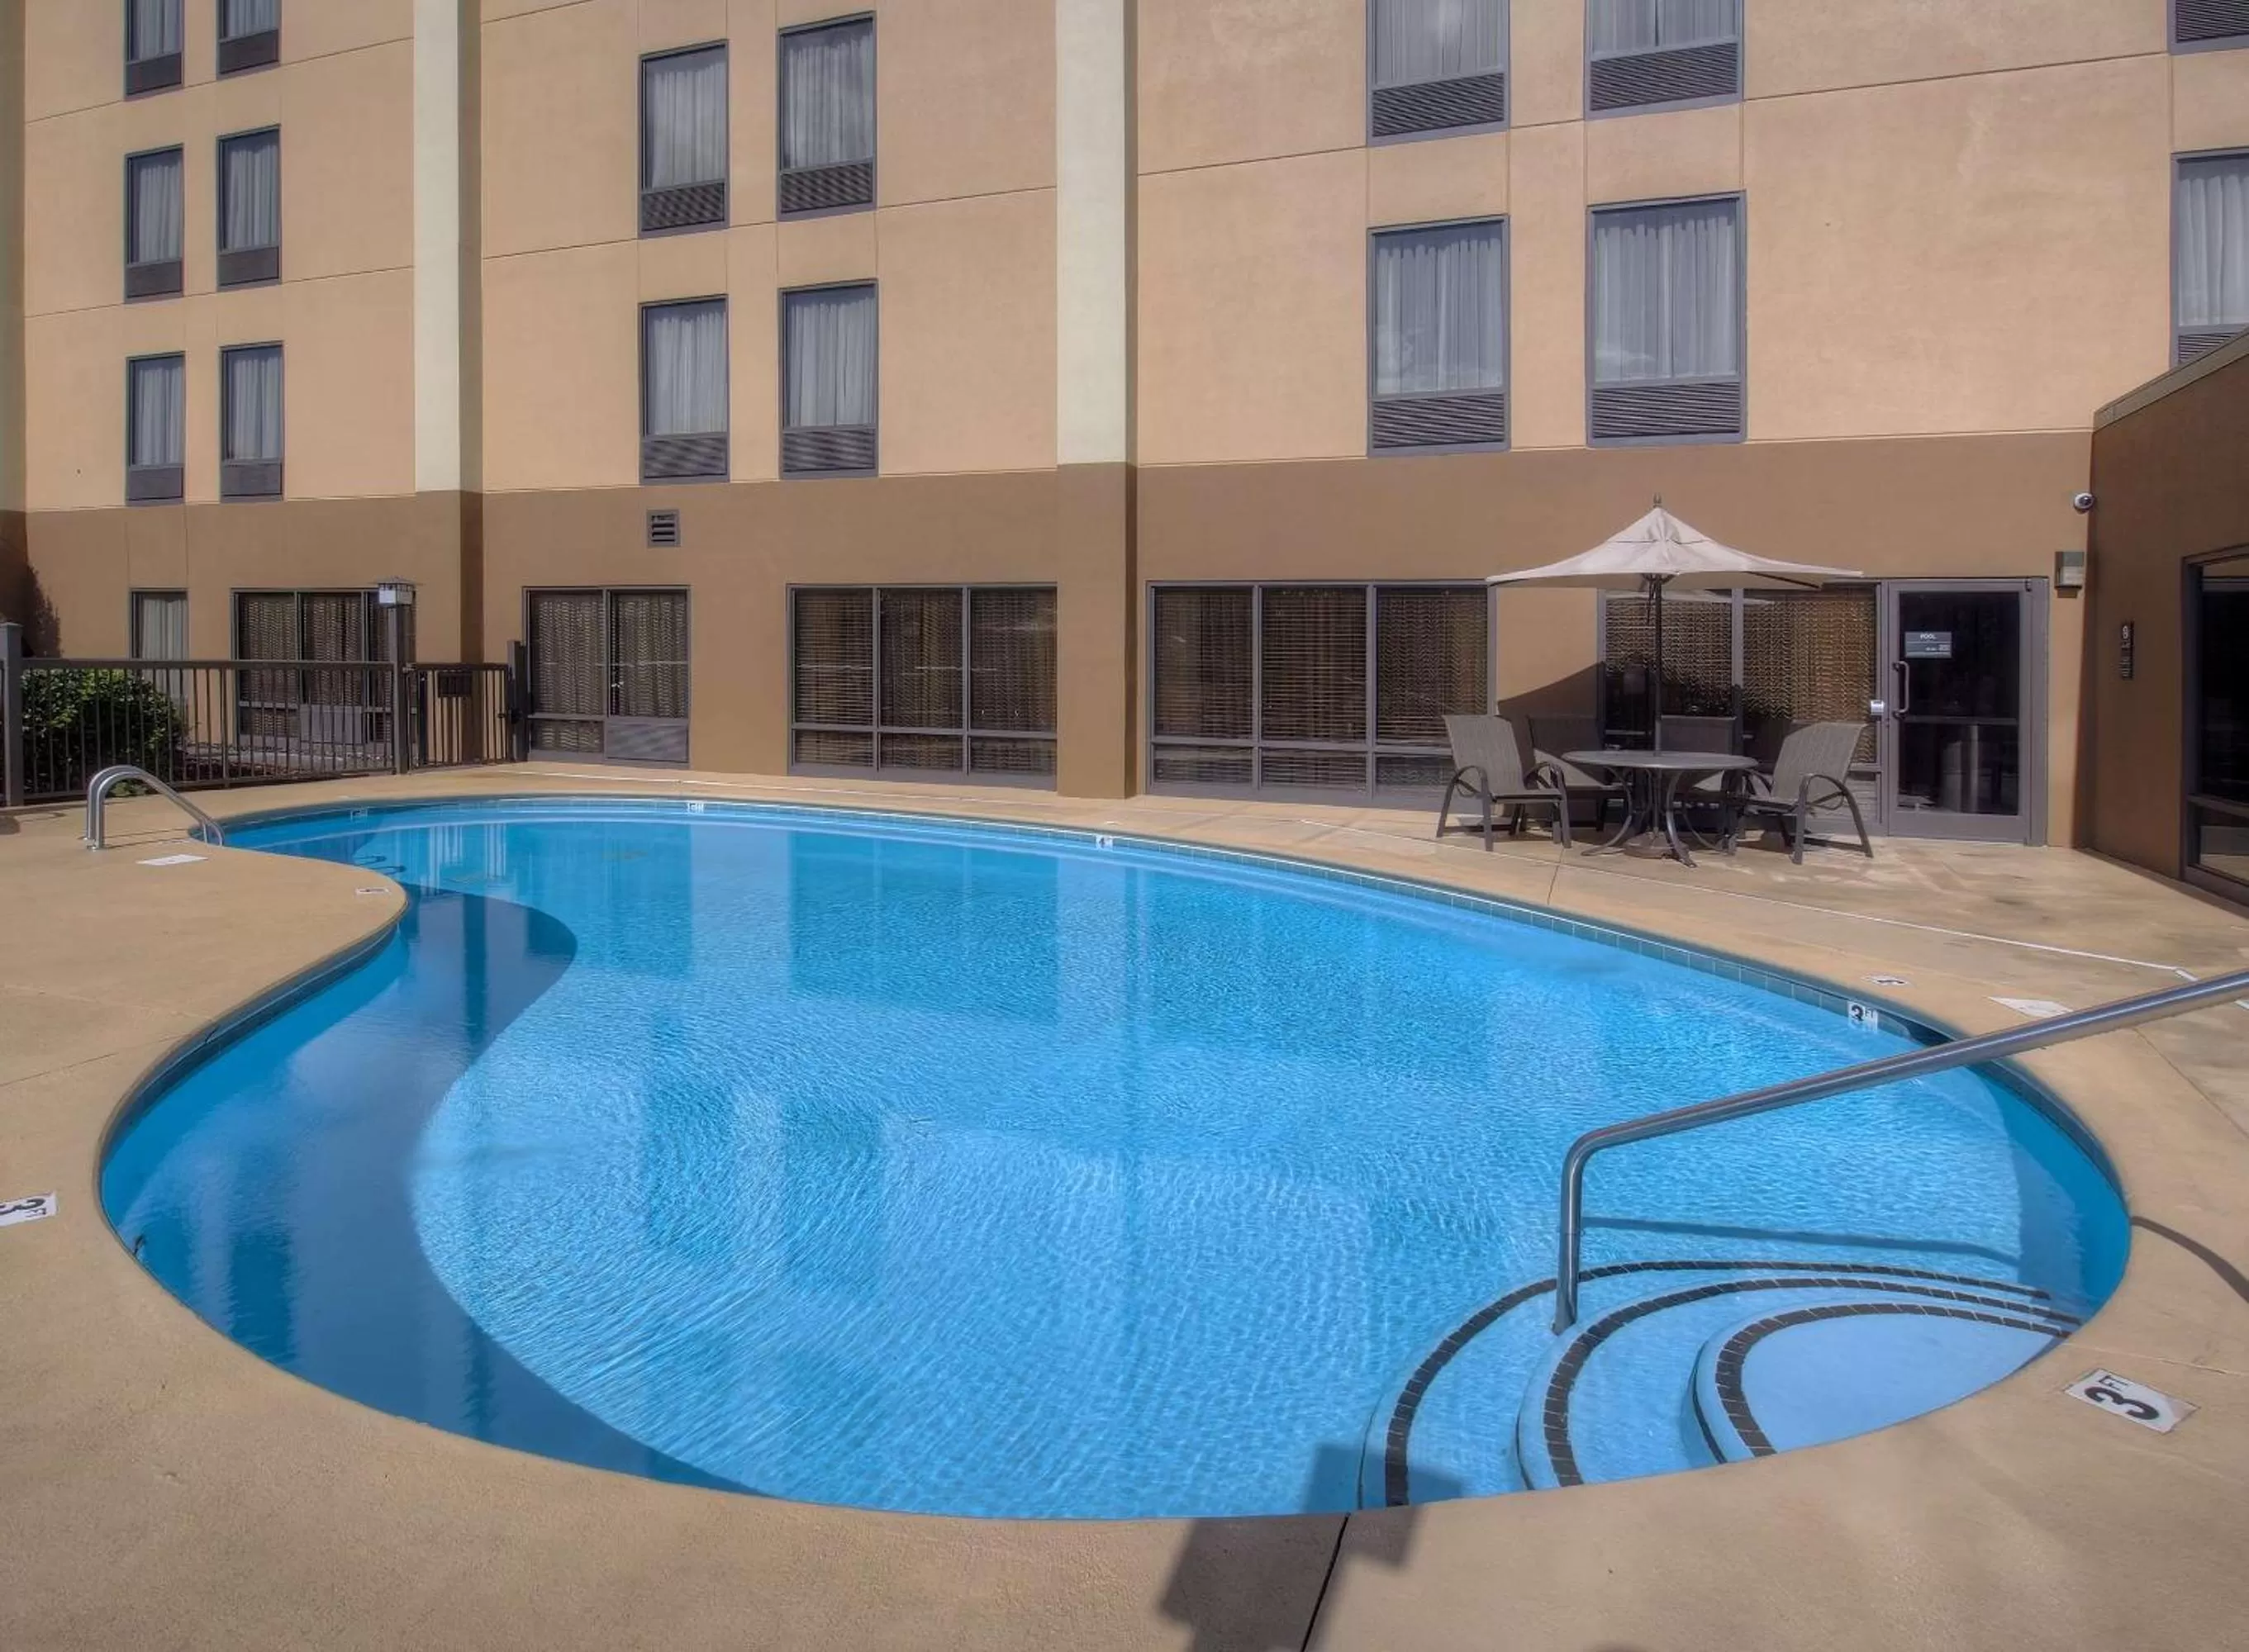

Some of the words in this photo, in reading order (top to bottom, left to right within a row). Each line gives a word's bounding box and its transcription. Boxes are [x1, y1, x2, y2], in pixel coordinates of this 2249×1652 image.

[1919, 633, 1938, 641] POOL
[2099, 1374, 2129, 1392] FT
[2084, 1385, 2160, 1421] 3
